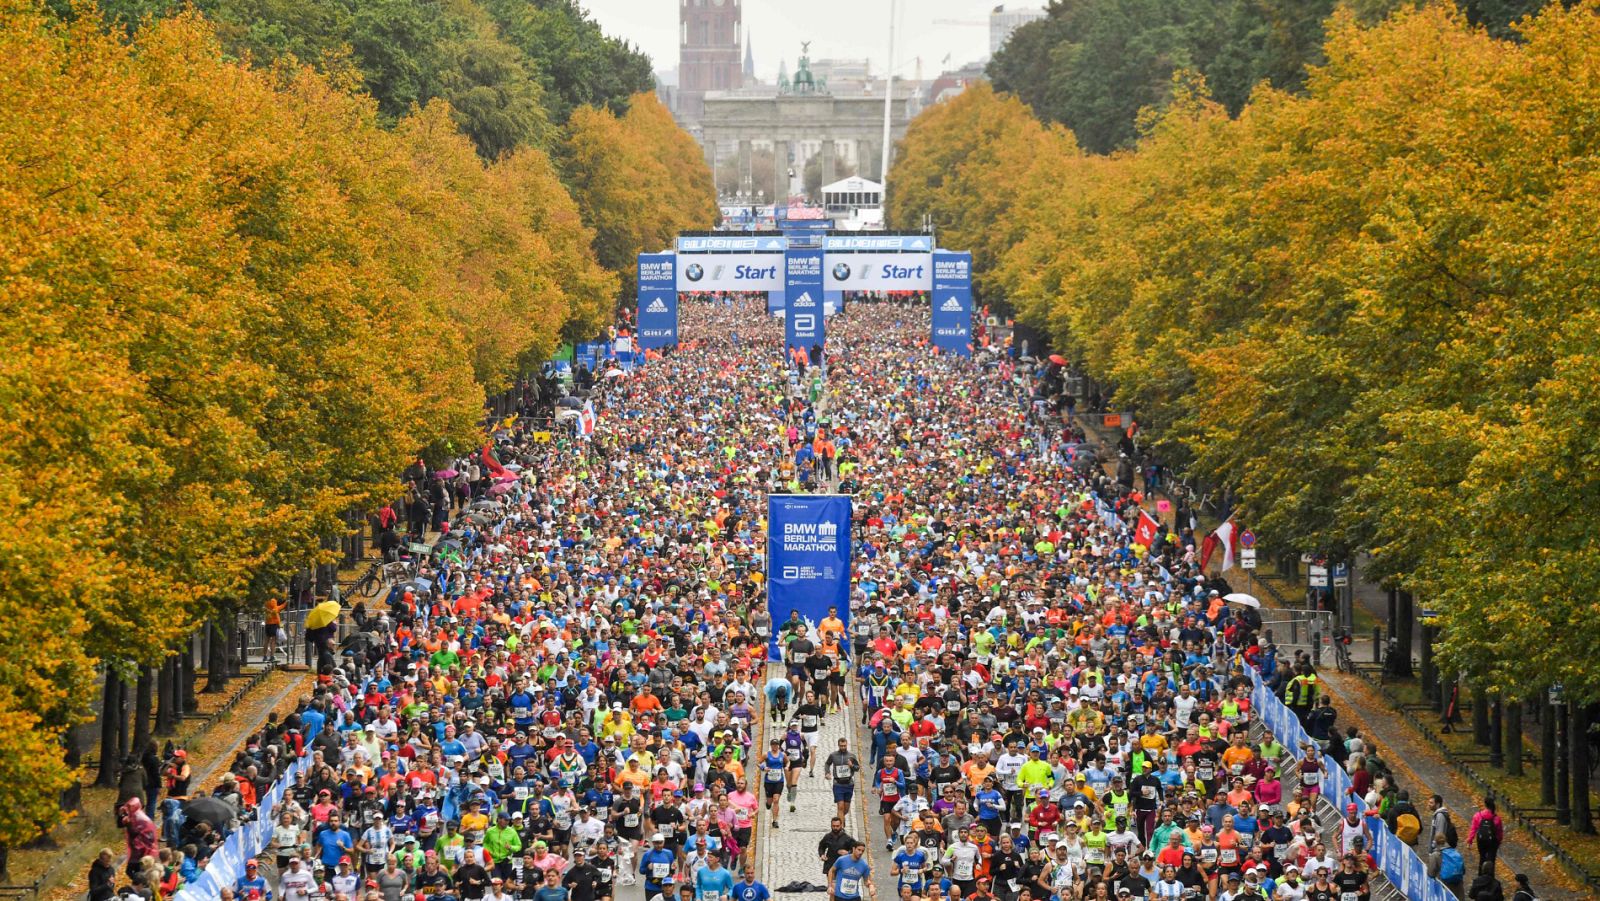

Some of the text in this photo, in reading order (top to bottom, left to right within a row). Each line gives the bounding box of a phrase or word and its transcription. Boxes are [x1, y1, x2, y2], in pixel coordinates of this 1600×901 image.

[734, 264, 776, 279] Start
[881, 264, 923, 279] Start
[784, 523, 816, 534] BMW
[784, 544, 836, 552] MARATHON
[1336, 562, 1345, 575] P
